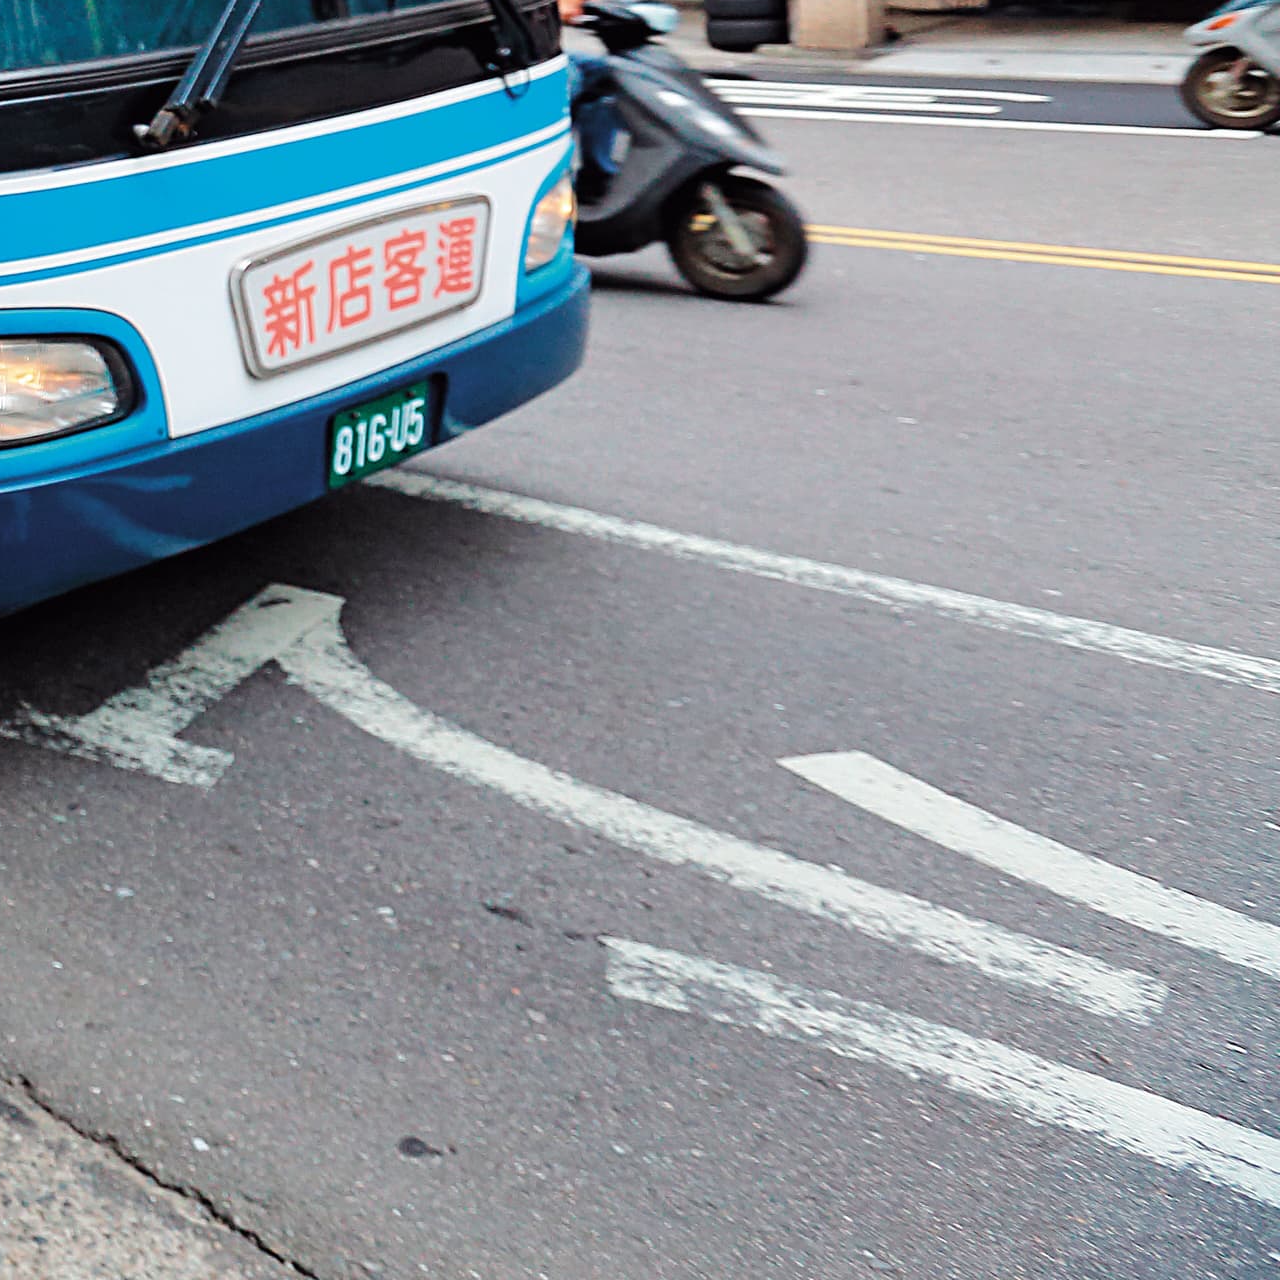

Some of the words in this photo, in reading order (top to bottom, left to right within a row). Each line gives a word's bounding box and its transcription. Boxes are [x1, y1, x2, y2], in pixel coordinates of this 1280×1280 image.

[263, 216, 476, 358] 新店客運
[333, 398, 426, 476] 816-U5
